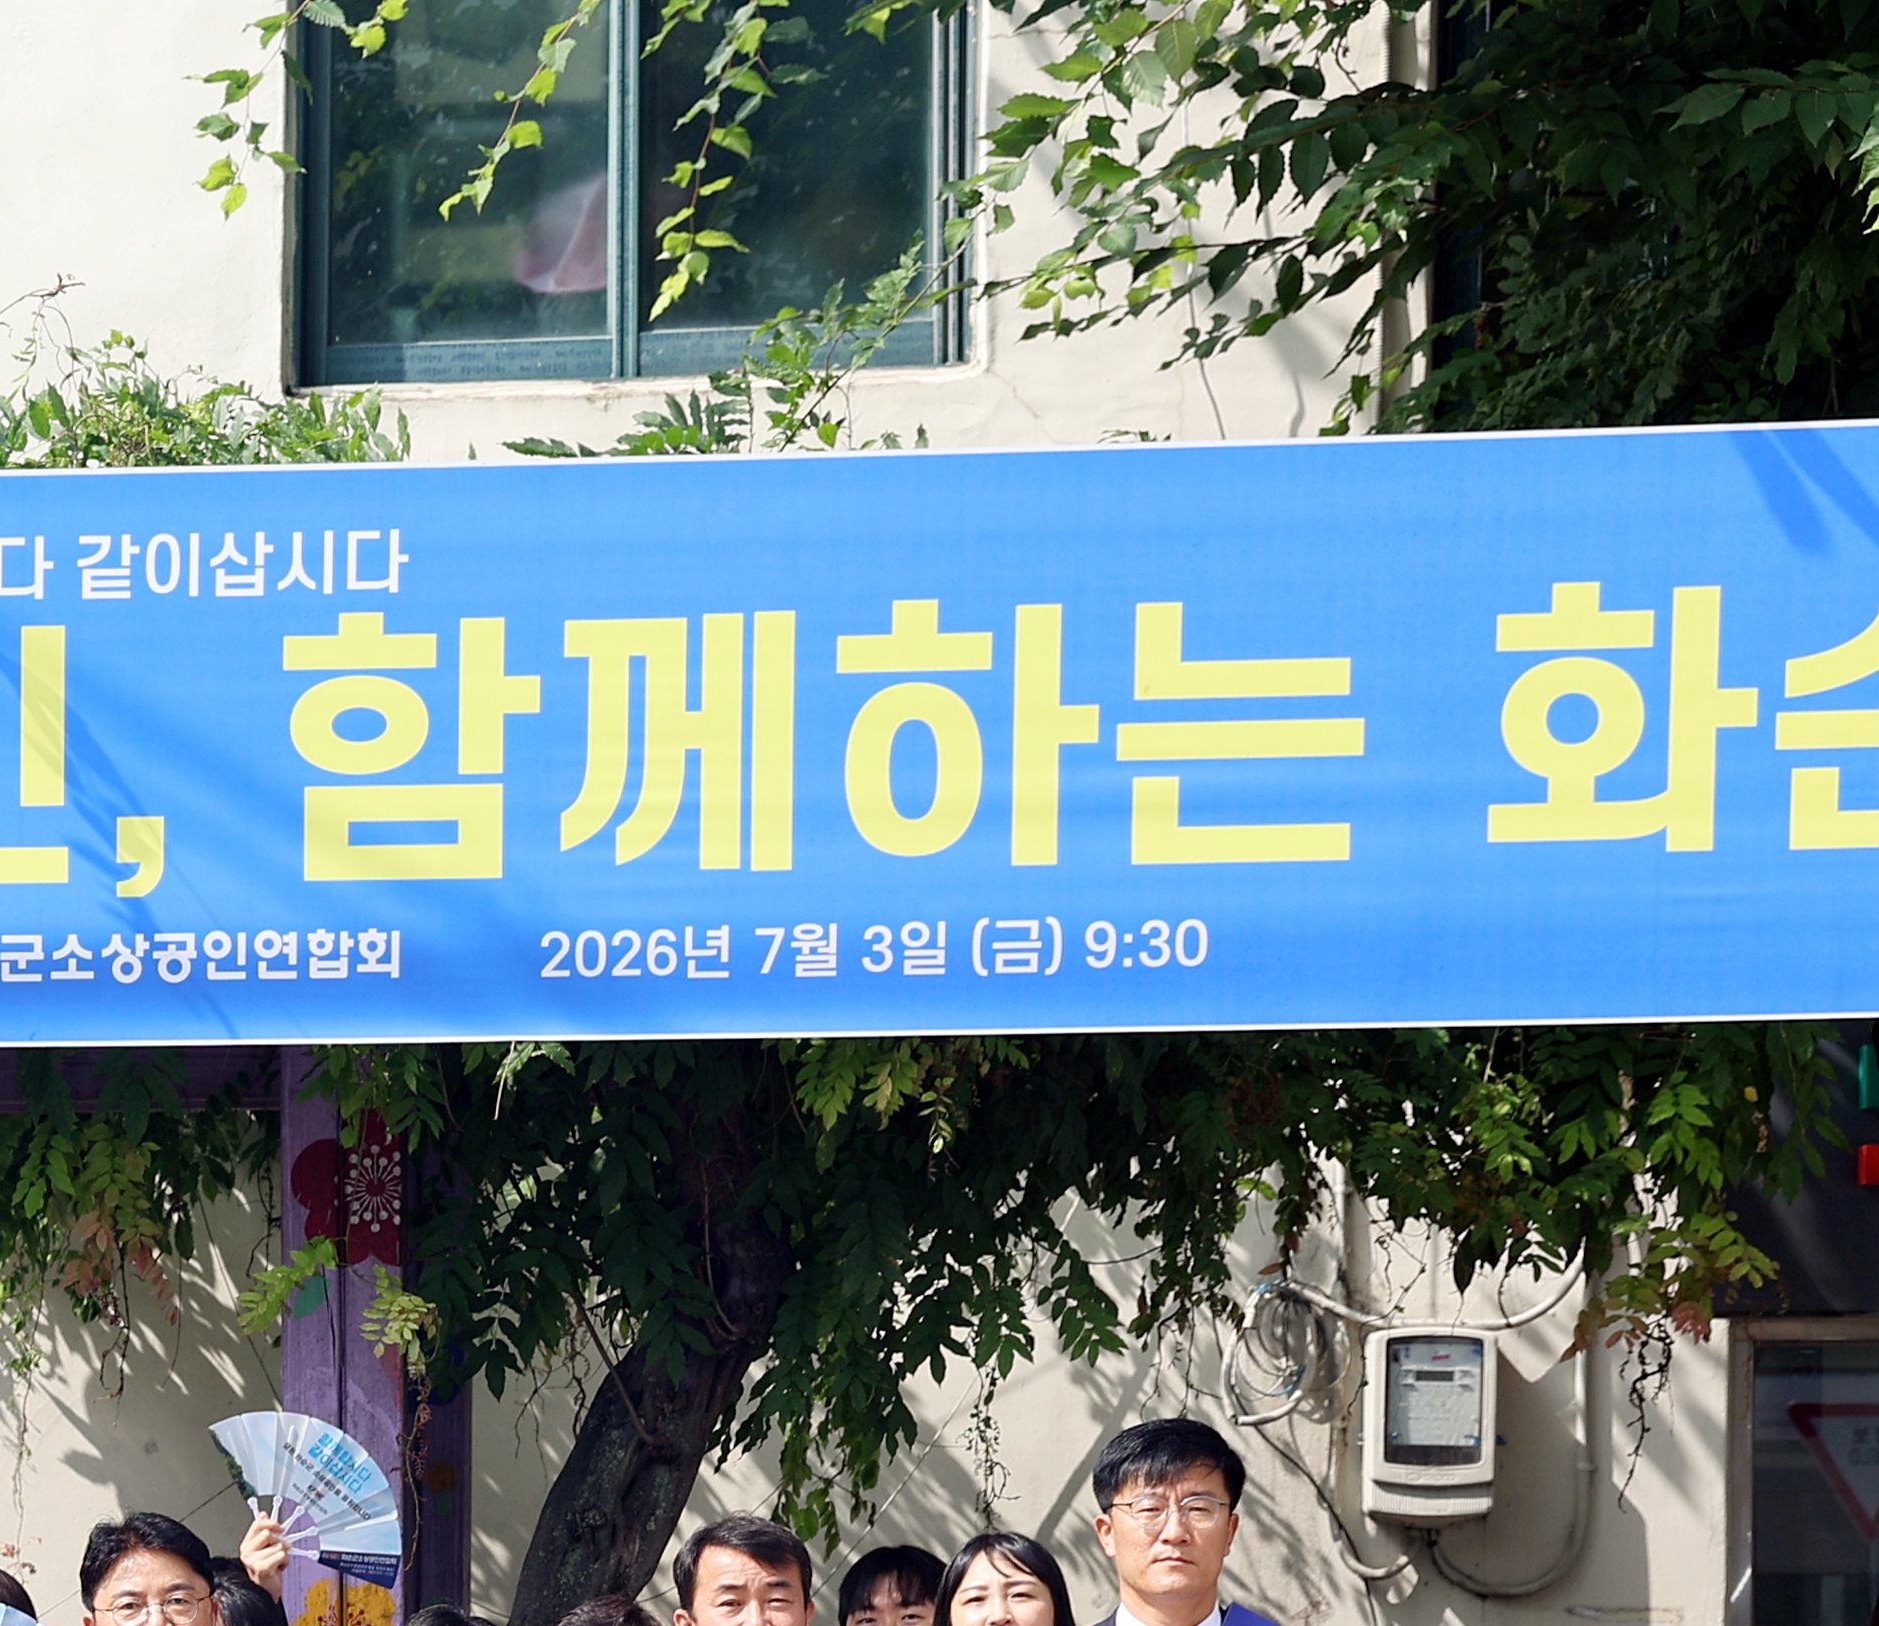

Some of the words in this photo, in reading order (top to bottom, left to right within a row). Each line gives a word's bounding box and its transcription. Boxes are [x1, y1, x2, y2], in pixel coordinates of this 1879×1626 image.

[77, 525, 410, 600] 같이삽시다
[282, 598, 1366, 882] 함께하는
[539, 925, 732, 981] 2026년
[756, 922, 839, 979] 7월
[862, 920, 948, 977] 3일
[971, 916, 1062, 978] (금)
[1085, 917, 1209, 971] 9:30
